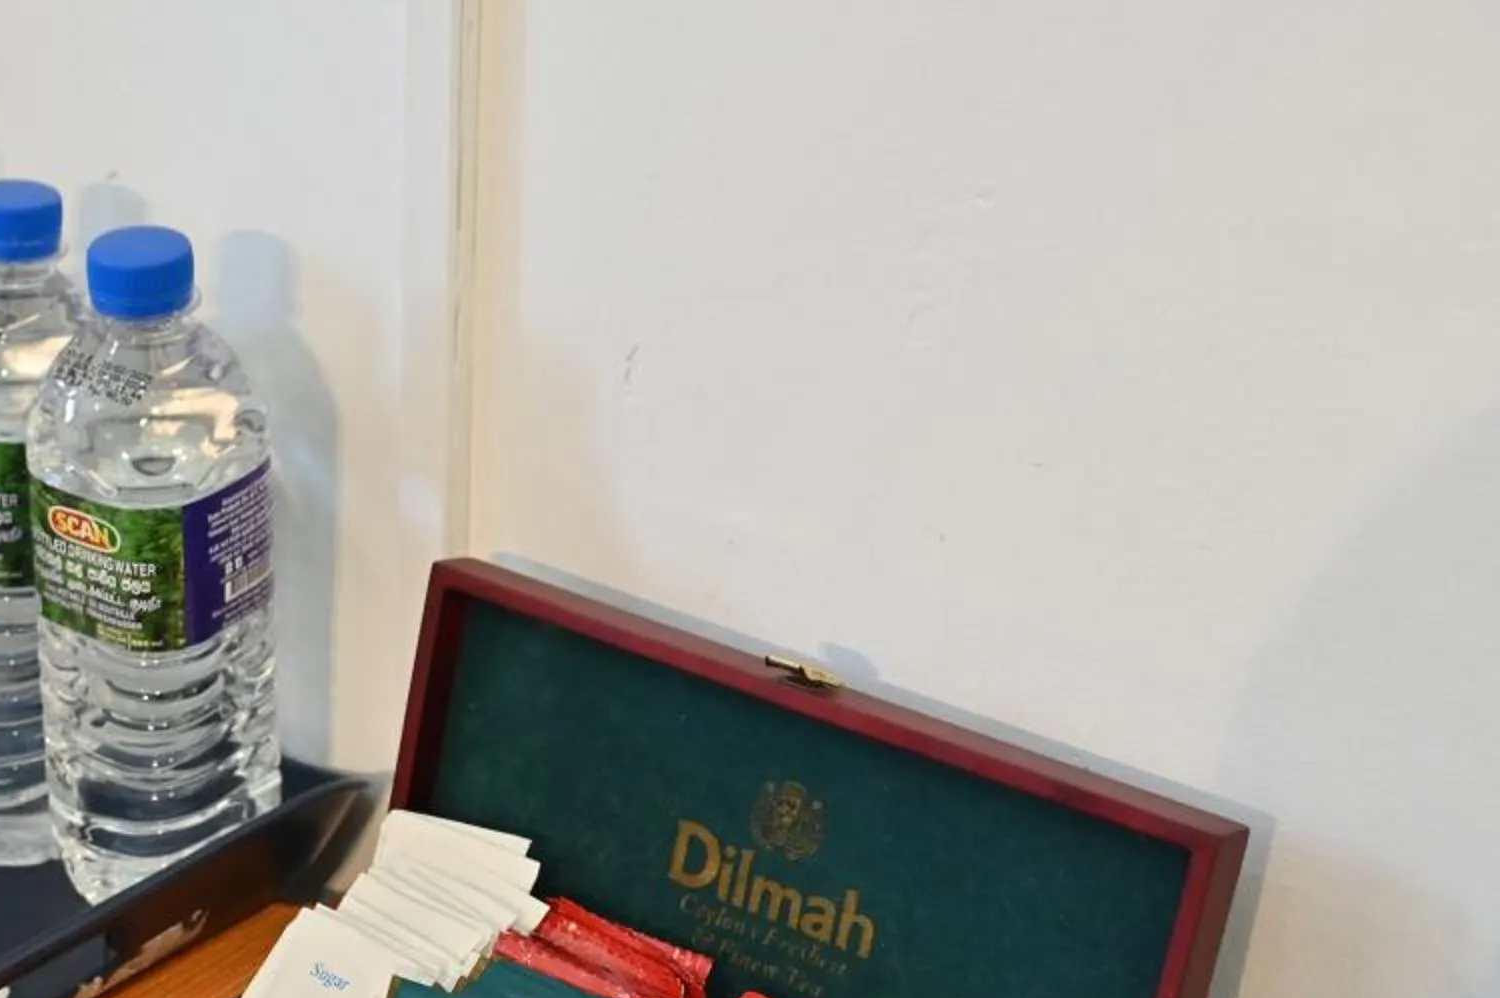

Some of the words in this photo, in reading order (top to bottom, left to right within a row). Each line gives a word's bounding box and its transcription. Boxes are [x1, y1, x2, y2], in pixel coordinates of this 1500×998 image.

[52, 511, 113, 550] SCAN
[114, 560, 157, 578] WATER
[667, 818, 876, 960] Dilmah
[309, 961, 352, 992] Sugar
